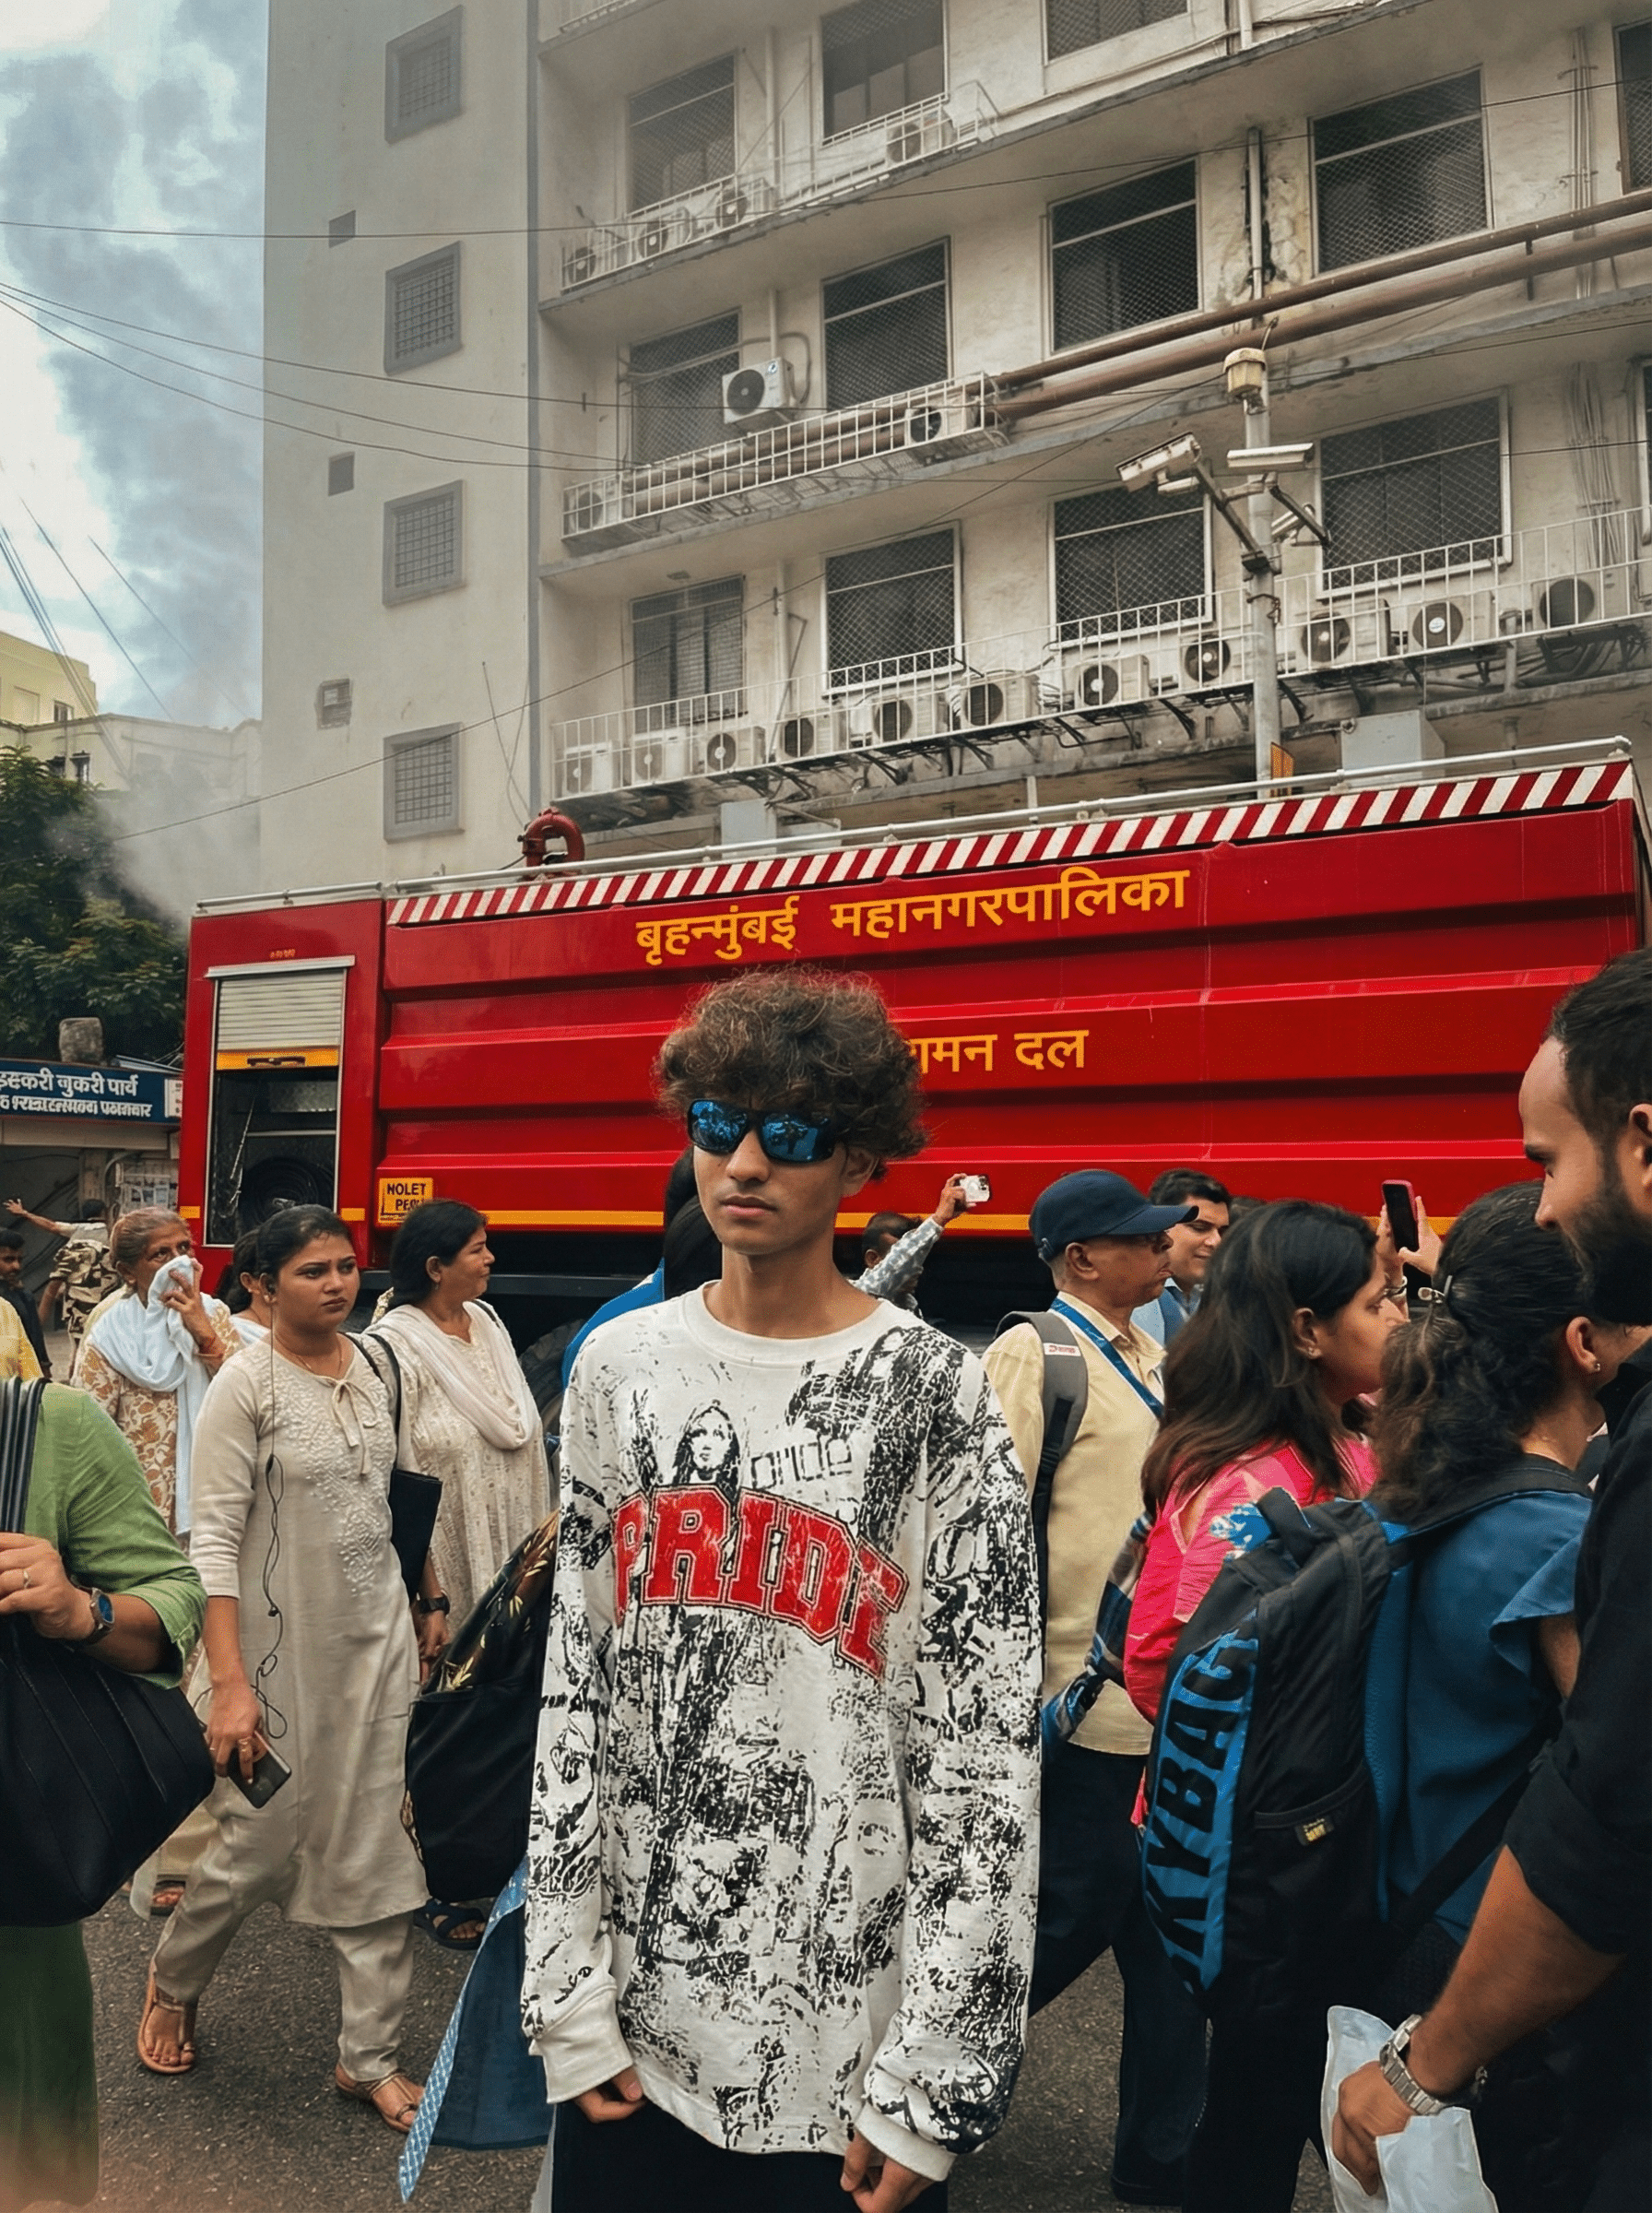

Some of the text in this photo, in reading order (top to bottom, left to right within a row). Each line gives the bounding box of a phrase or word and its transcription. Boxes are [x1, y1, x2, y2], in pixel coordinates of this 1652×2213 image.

[636, 867, 1190, 965] बृहन्मुंबई महानगरपालिका
[1013, 1029, 1090, 1071] दल
[612, 1483, 910, 1683] PRIDE
[1145, 1627, 1258, 1996] KYBAG
